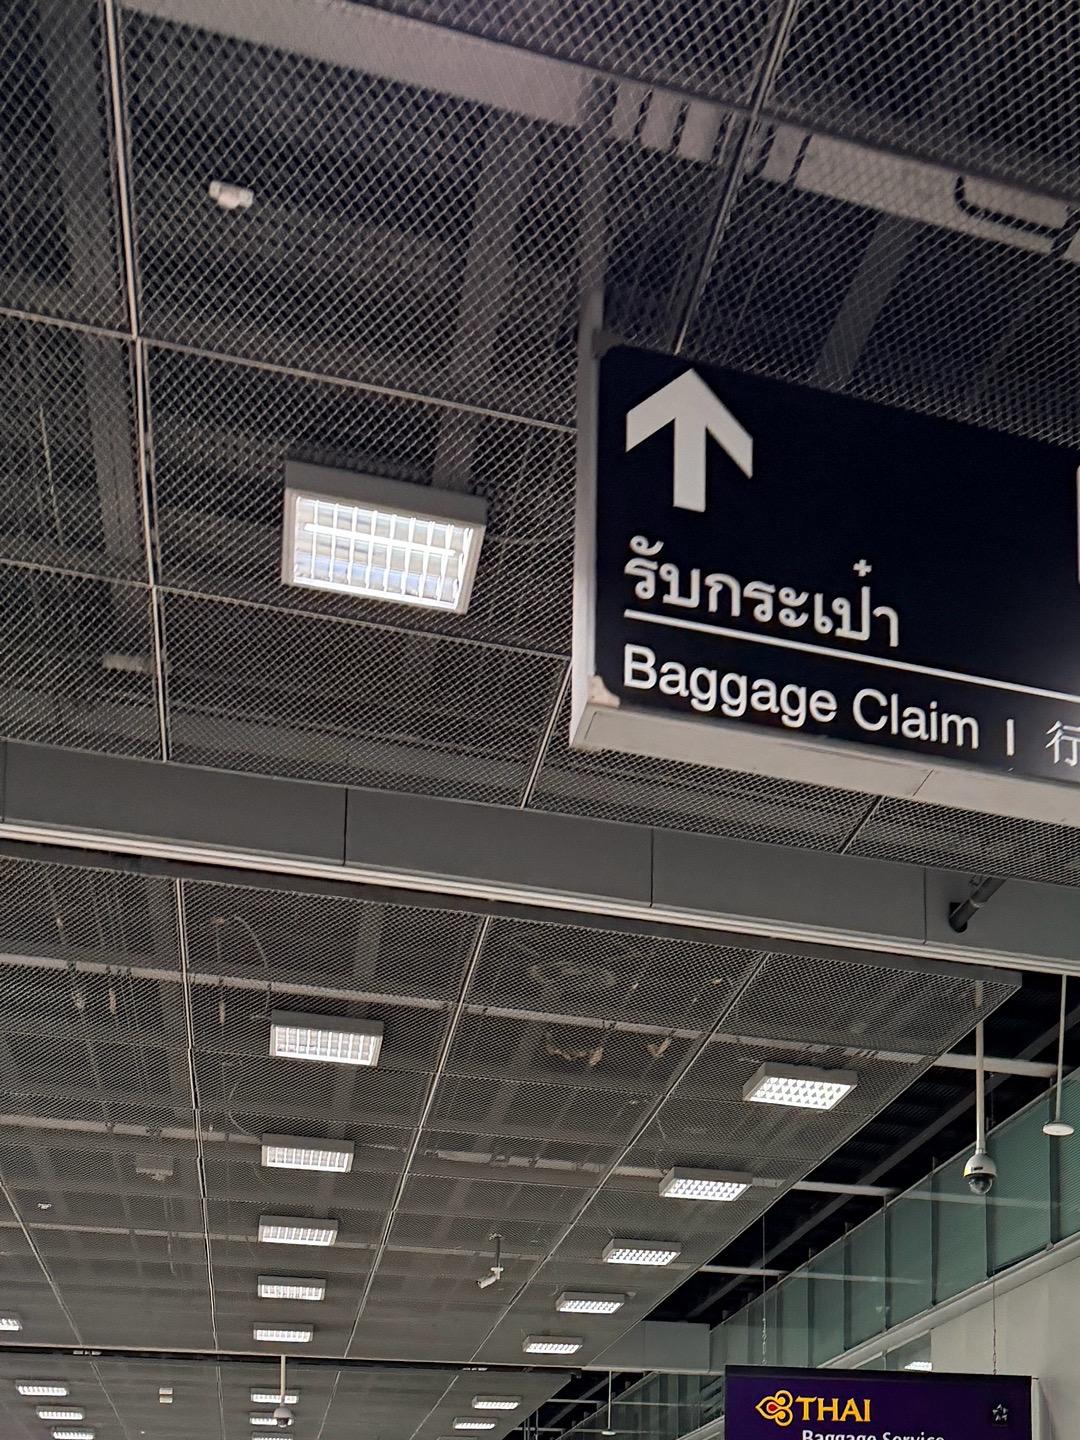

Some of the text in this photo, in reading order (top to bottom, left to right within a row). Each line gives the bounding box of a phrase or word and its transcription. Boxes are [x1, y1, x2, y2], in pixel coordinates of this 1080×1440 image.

[624, 534, 900, 647] รับกระเป๋า
[623, 643, 837, 729] Baggage
[852, 688, 980, 750] Claim
[795, 1396, 872, 1422] THAI
